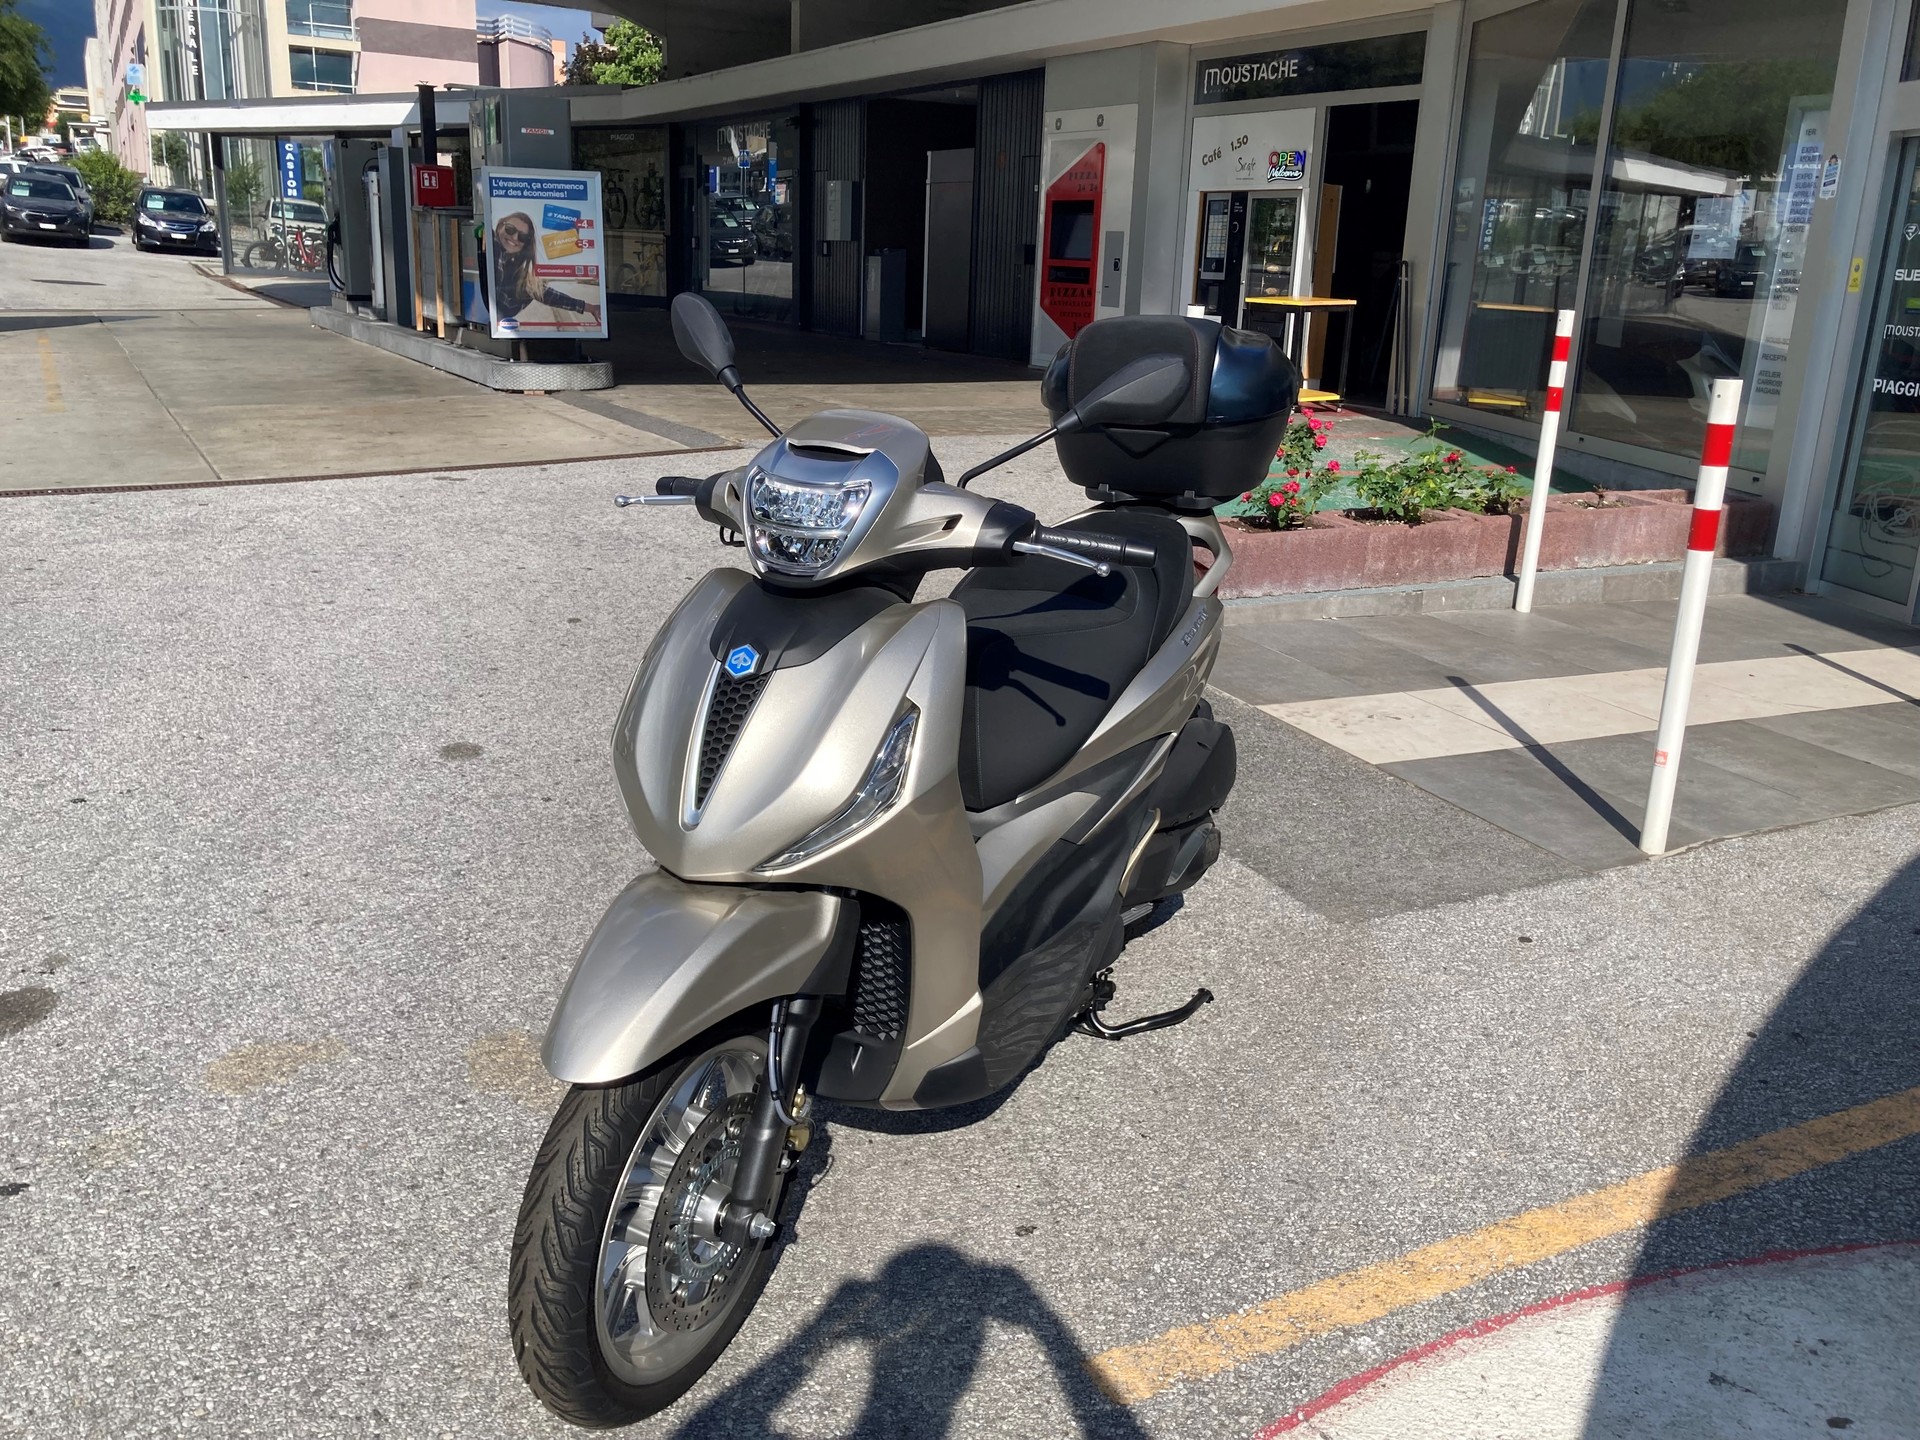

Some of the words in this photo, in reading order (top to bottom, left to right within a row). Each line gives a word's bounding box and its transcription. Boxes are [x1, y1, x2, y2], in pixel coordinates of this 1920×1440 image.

[1204, 60, 1298, 94] MOUSTACHE
[610, 133, 635, 141] PIAGGIO
[341, 141, 349, 149] 4
[1202, 147, 1222, 166] Café
[1231, 135, 1249, 151] 1.50
[1267, 150, 1307, 167] OPEN
[1267, 165, 1303, 182] Welcome
[492, 180, 531, 189] L'évasion,
[532, 182, 541, 190] ça
[523, 189, 568, 198] économies!
[1050, 287, 1093, 297] PIZZAS
[1884, 324, 1920, 339] MOUST
[1873, 378, 1920, 398] PIAGGI
